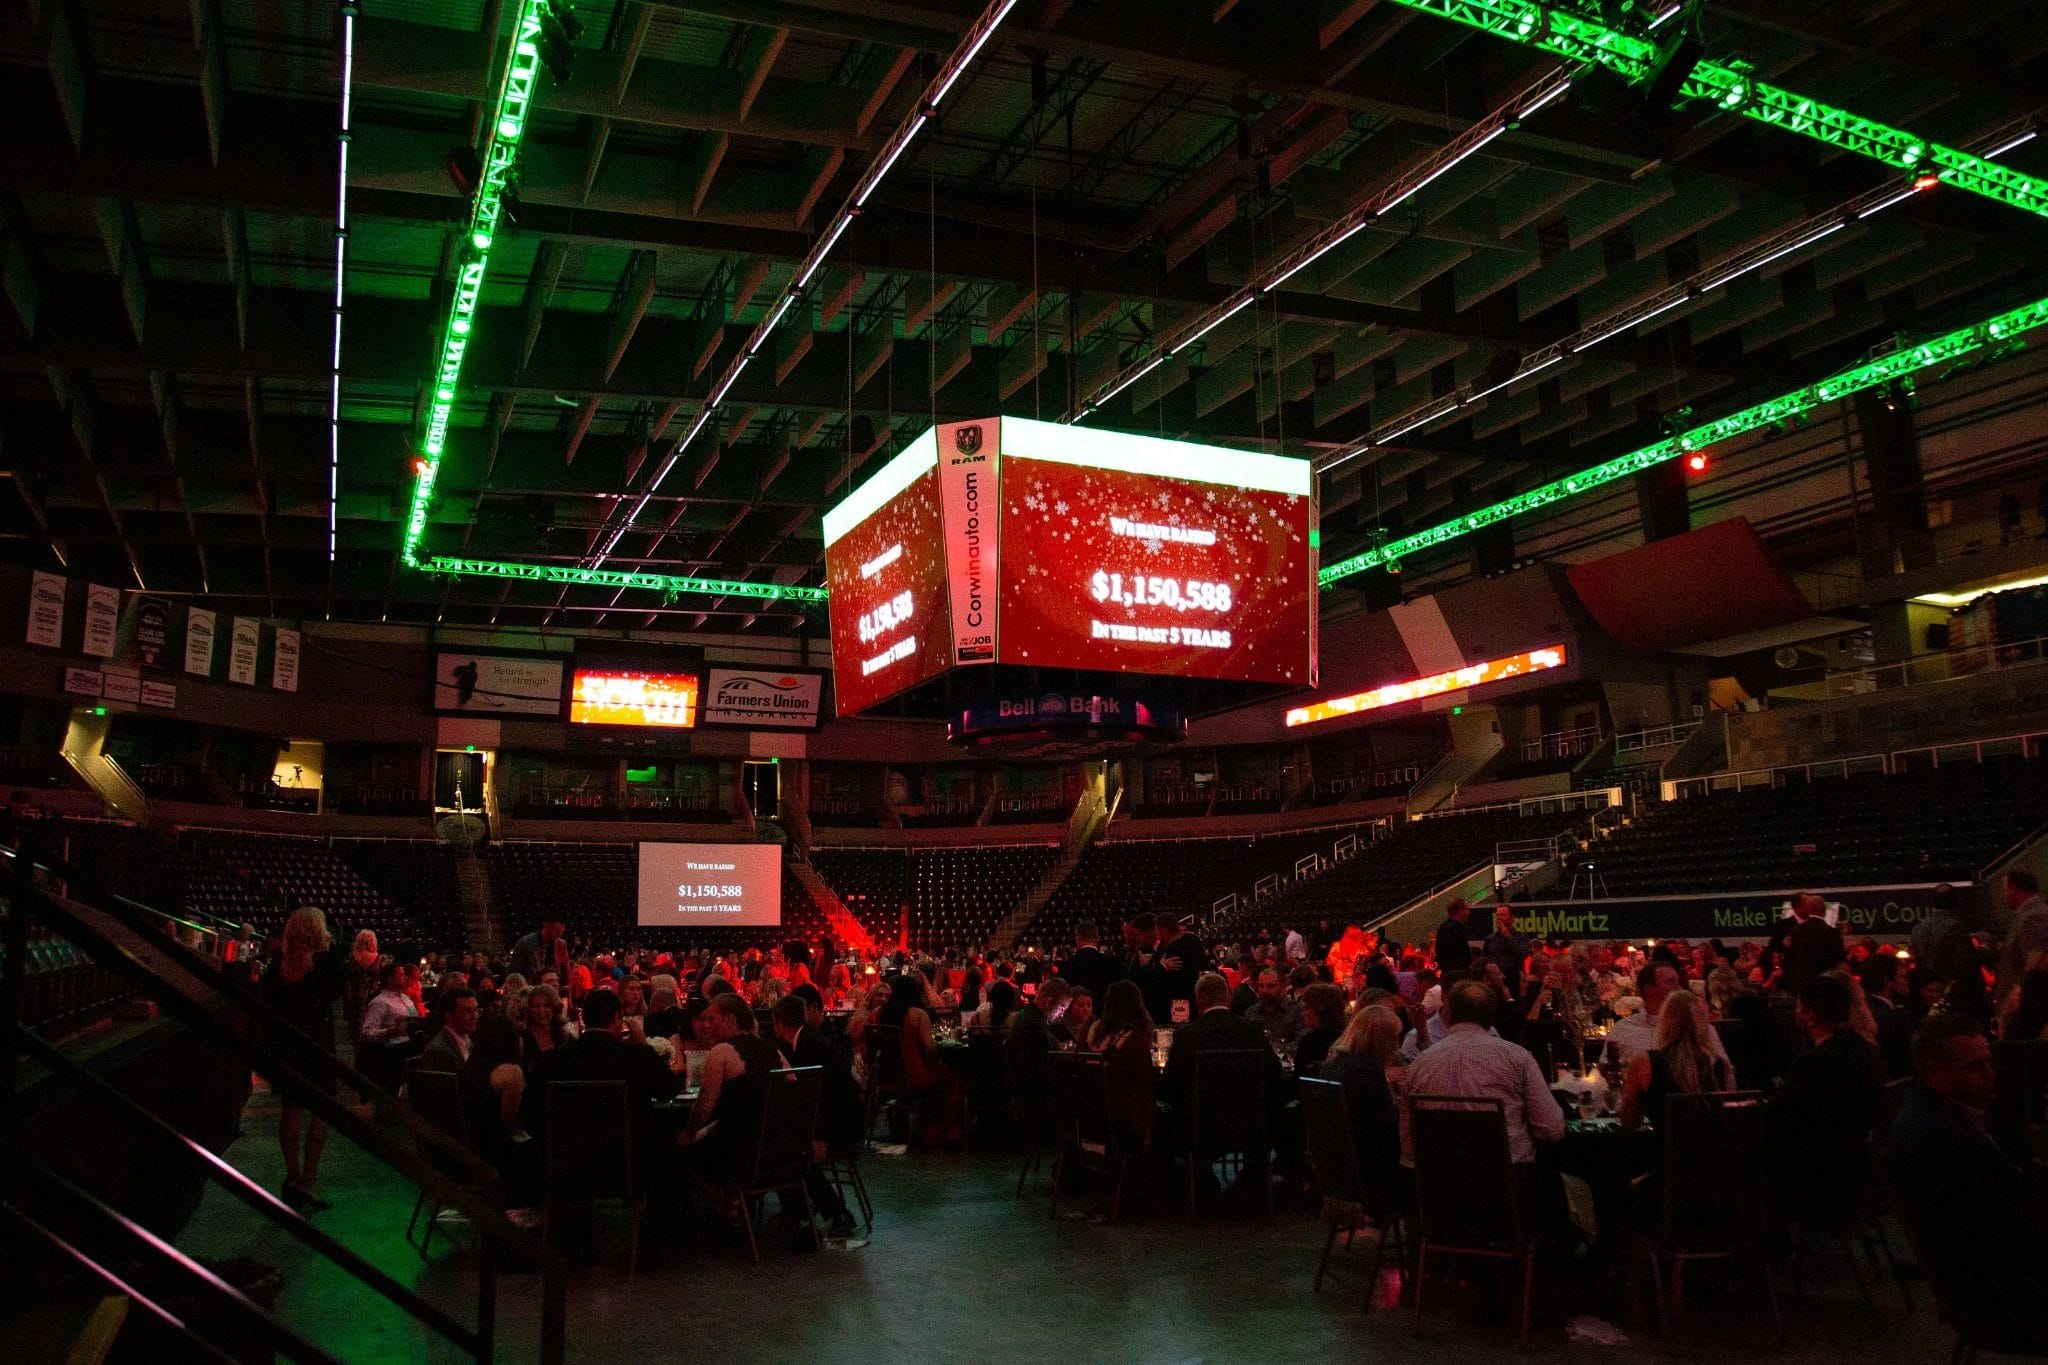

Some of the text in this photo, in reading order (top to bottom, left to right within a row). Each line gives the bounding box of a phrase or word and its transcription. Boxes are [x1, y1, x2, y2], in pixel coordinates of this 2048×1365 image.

[951, 455, 986, 465] RAM
[965, 472, 982, 627] Corwinauto.com
[1092, 570, 1231, 611] $1,150,588
[973, 636, 991, 645] JOB
[1170, 627, 1180, 644] 5
[1181, 628, 1231, 648] YEARS
[493, 666, 523, 676] Return
[512, 677, 549, 687] strength
[717, 690, 810, 709] Farmers Union
[1000, 697, 1120, 716] Bell Bank
[678, 884, 742, 898] $1,150,588
[719, 904, 742, 912] YEARS
[1714, 908, 1767, 928] Make
[1838, 904, 1878, 929] Day
[1883, 901, 1931, 923] Cou
[1492, 910, 1609, 938] adyMartz
